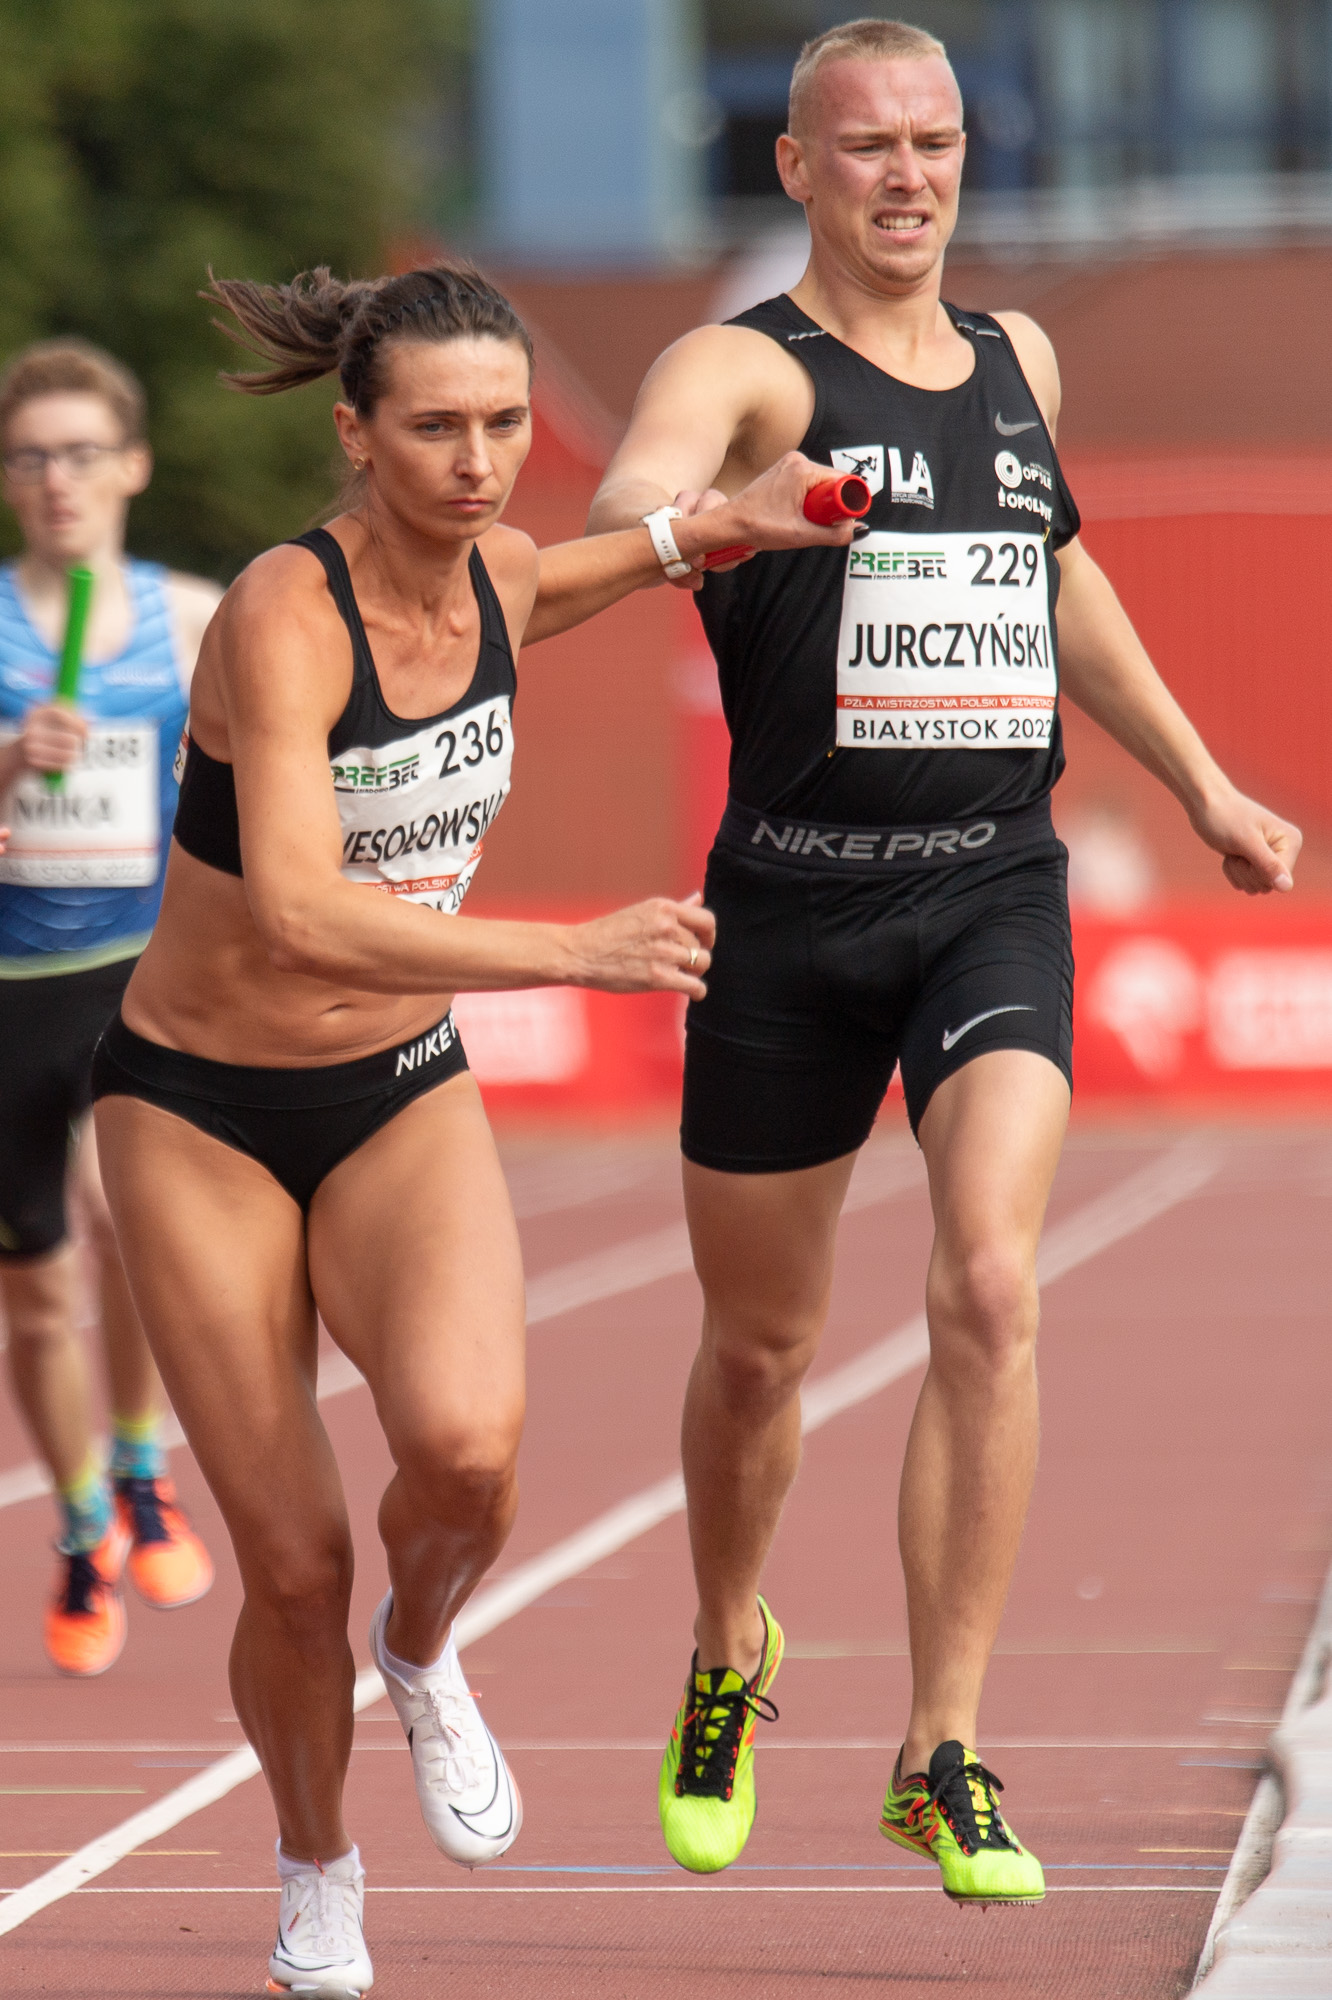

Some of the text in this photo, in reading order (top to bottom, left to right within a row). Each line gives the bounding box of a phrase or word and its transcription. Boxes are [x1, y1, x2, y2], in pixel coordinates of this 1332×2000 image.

[967, 543, 1038, 587] 229
[848, 612, 1049, 669] JURCZYŃSKI
[844, 698, 874, 708] PZLA
[876, 698, 958, 708] MISTRZOSTWA
[960, 698, 998, 708] POLSKI
[1000, 698, 1010, 707] W
[435, 709, 504, 779] 236
[852, 718, 999, 740] BIAŁYSTOK
[751, 820, 997, 860] NIKE PRO
[412, 878, 450, 891] POLSKI
[396, 1022, 452, 1077] NIKE
